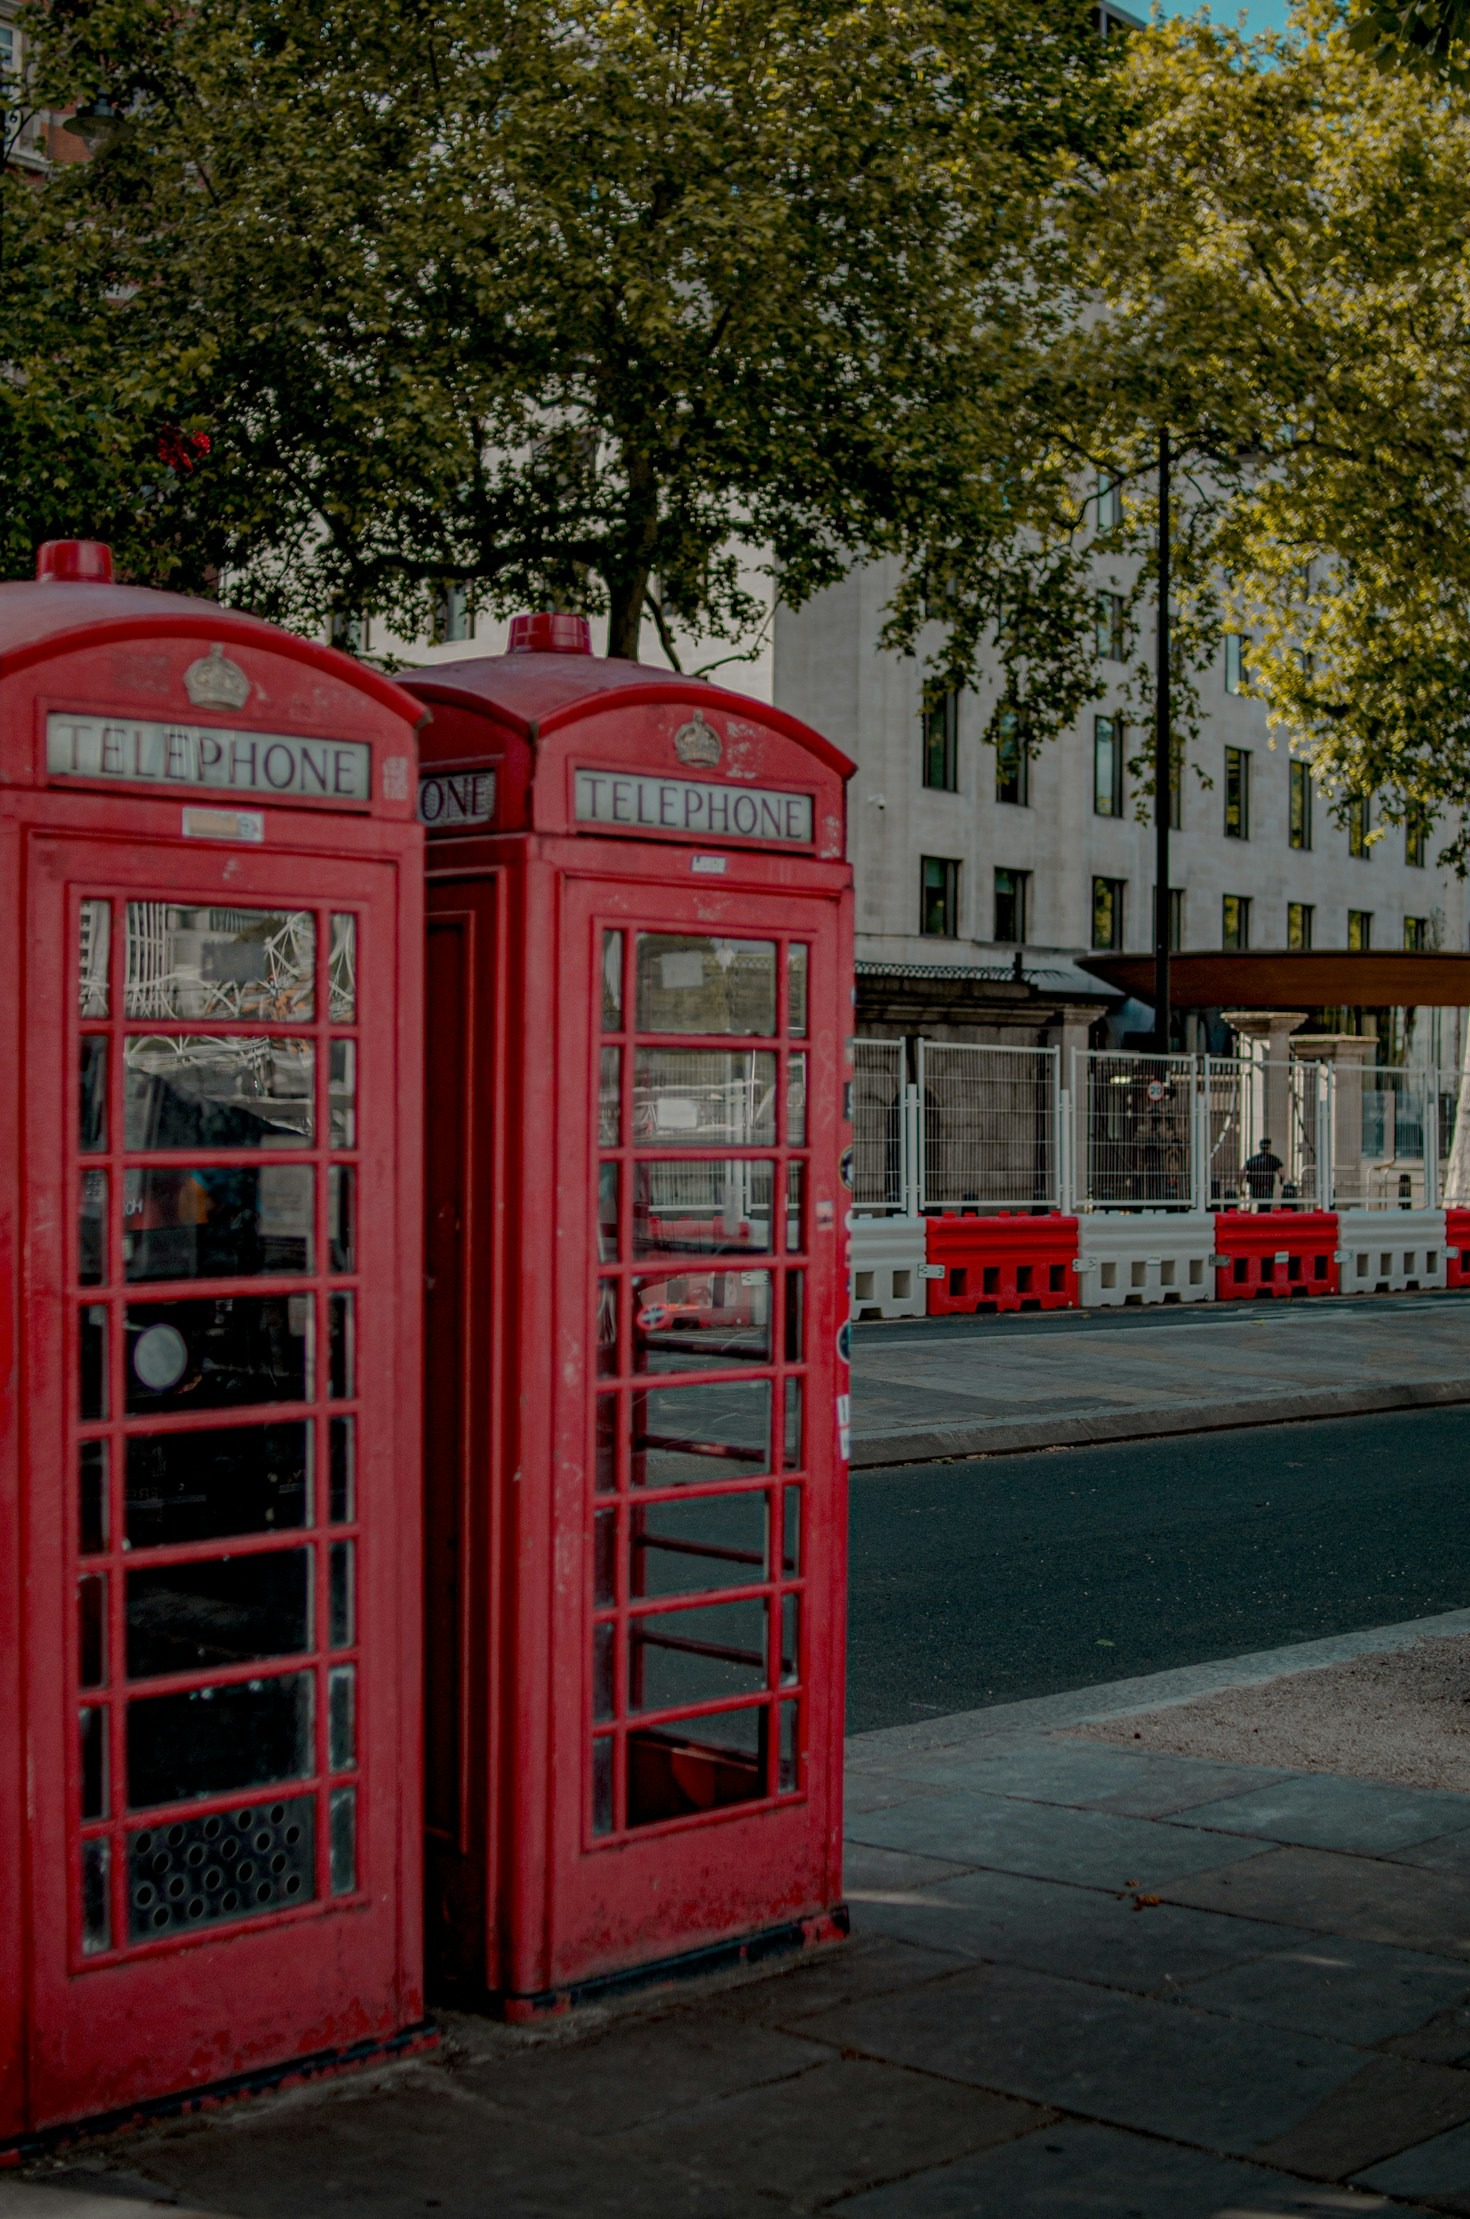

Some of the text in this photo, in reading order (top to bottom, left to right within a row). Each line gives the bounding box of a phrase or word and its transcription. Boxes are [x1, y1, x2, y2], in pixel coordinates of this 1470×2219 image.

[59, 723, 356, 795] TELEPHONE
[421, 775, 489, 821] ONE
[581, 777, 803, 838] TELEPHONE
